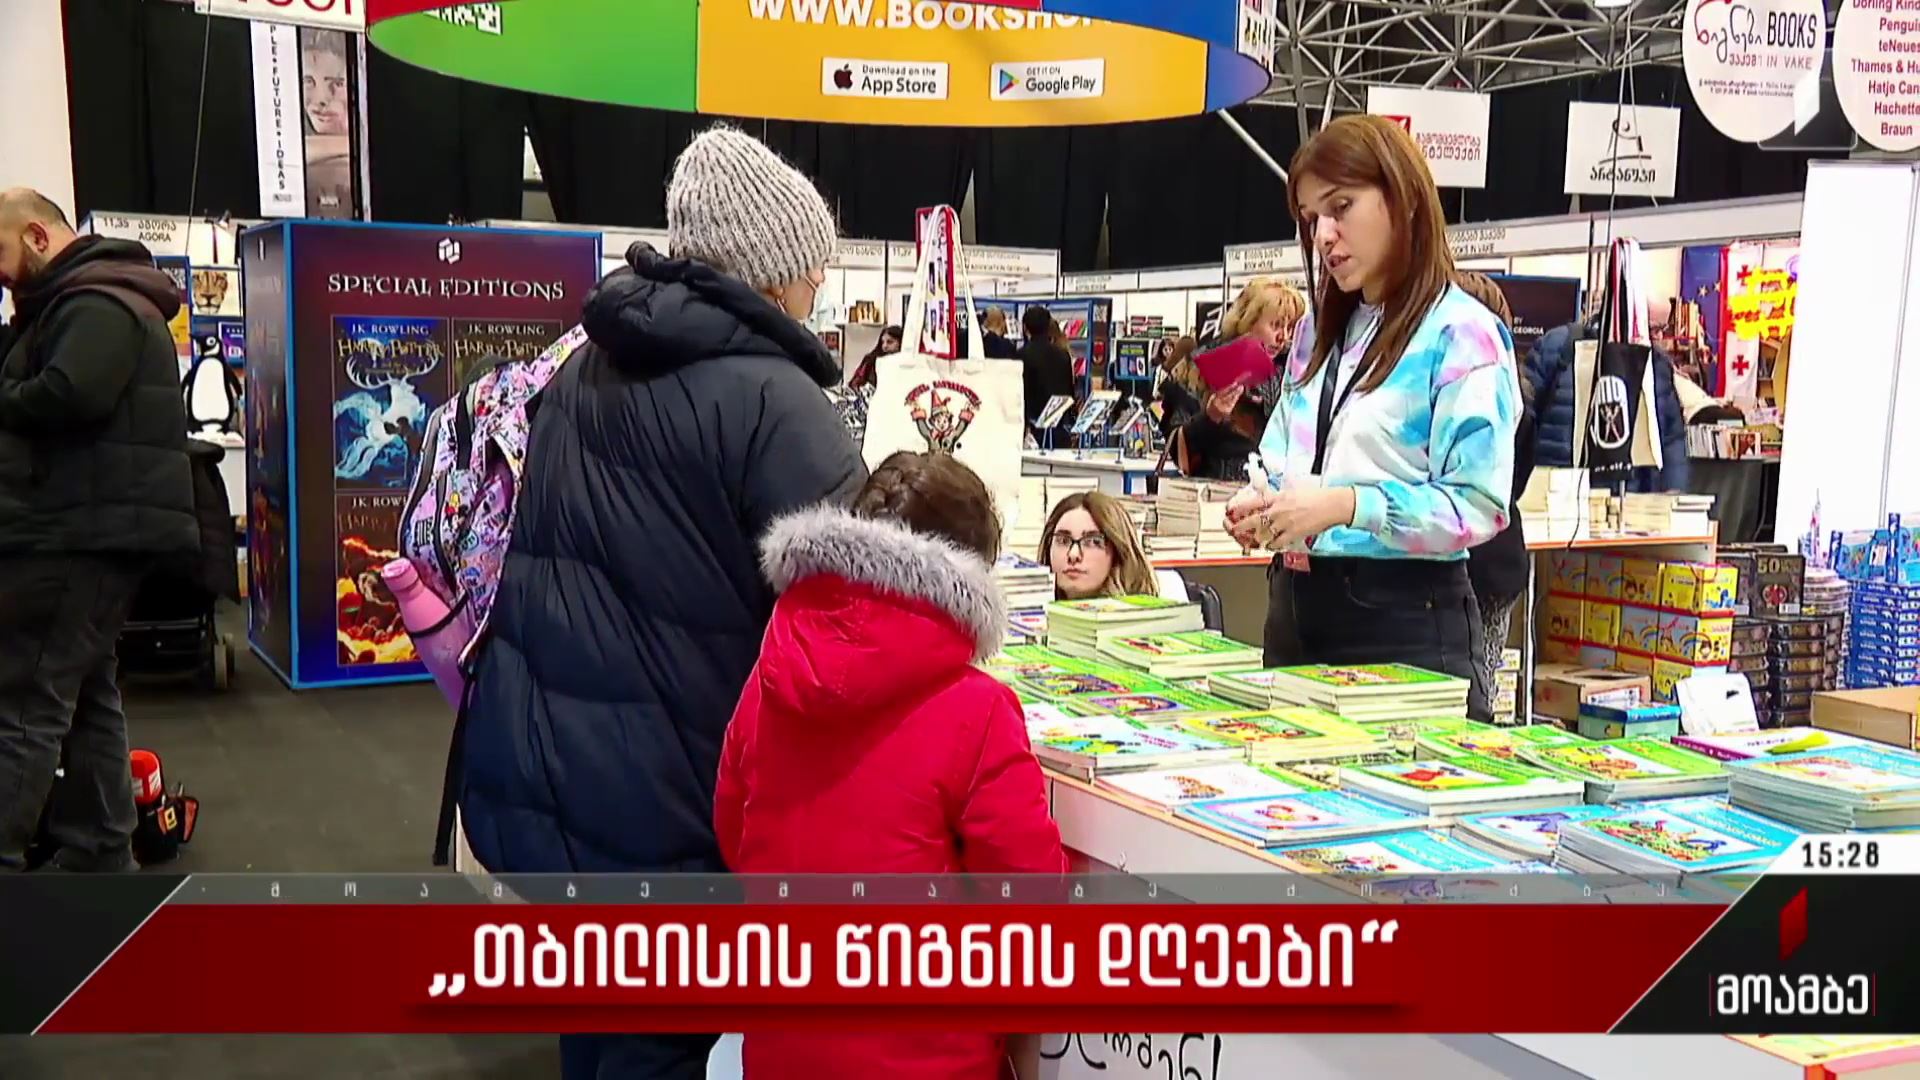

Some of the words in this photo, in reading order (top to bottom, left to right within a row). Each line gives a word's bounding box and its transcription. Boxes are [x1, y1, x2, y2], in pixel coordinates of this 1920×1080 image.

[1767, 11, 1817, 48] BOOKS
[862, 64, 907, 75] Download
[908, 66, 920, 75] on
[922, 66, 937, 76] the
[1766, 56, 1778, 68] IN
[1784, 57, 1813, 70] VAKE
[1851, 59, 1893, 73] Thames
[1895, 60, 1904, 73] &
[1026, 67, 1040, 76] GET
[861, 77, 893, 95] App
[896, 78, 937, 94] Store
[1025, 77, 1070, 95] Google
[1072, 75, 1096, 93] Play
[1868, 80, 1895, 97] Hatje
[272, 66, 283, 128] FUTURE
[1881, 122, 1913, 136] Braun
[276, 140, 286, 190] IDEAS
[138, 231, 171, 243] AGORA
[328, 273, 432, 297] SPECIAL
[440, 278, 565, 301] EDITIONS
[371, 324, 430, 335] ROWLING
[487, 325, 546, 336] ROWLING
[455, 339, 505, 358] HARRY
